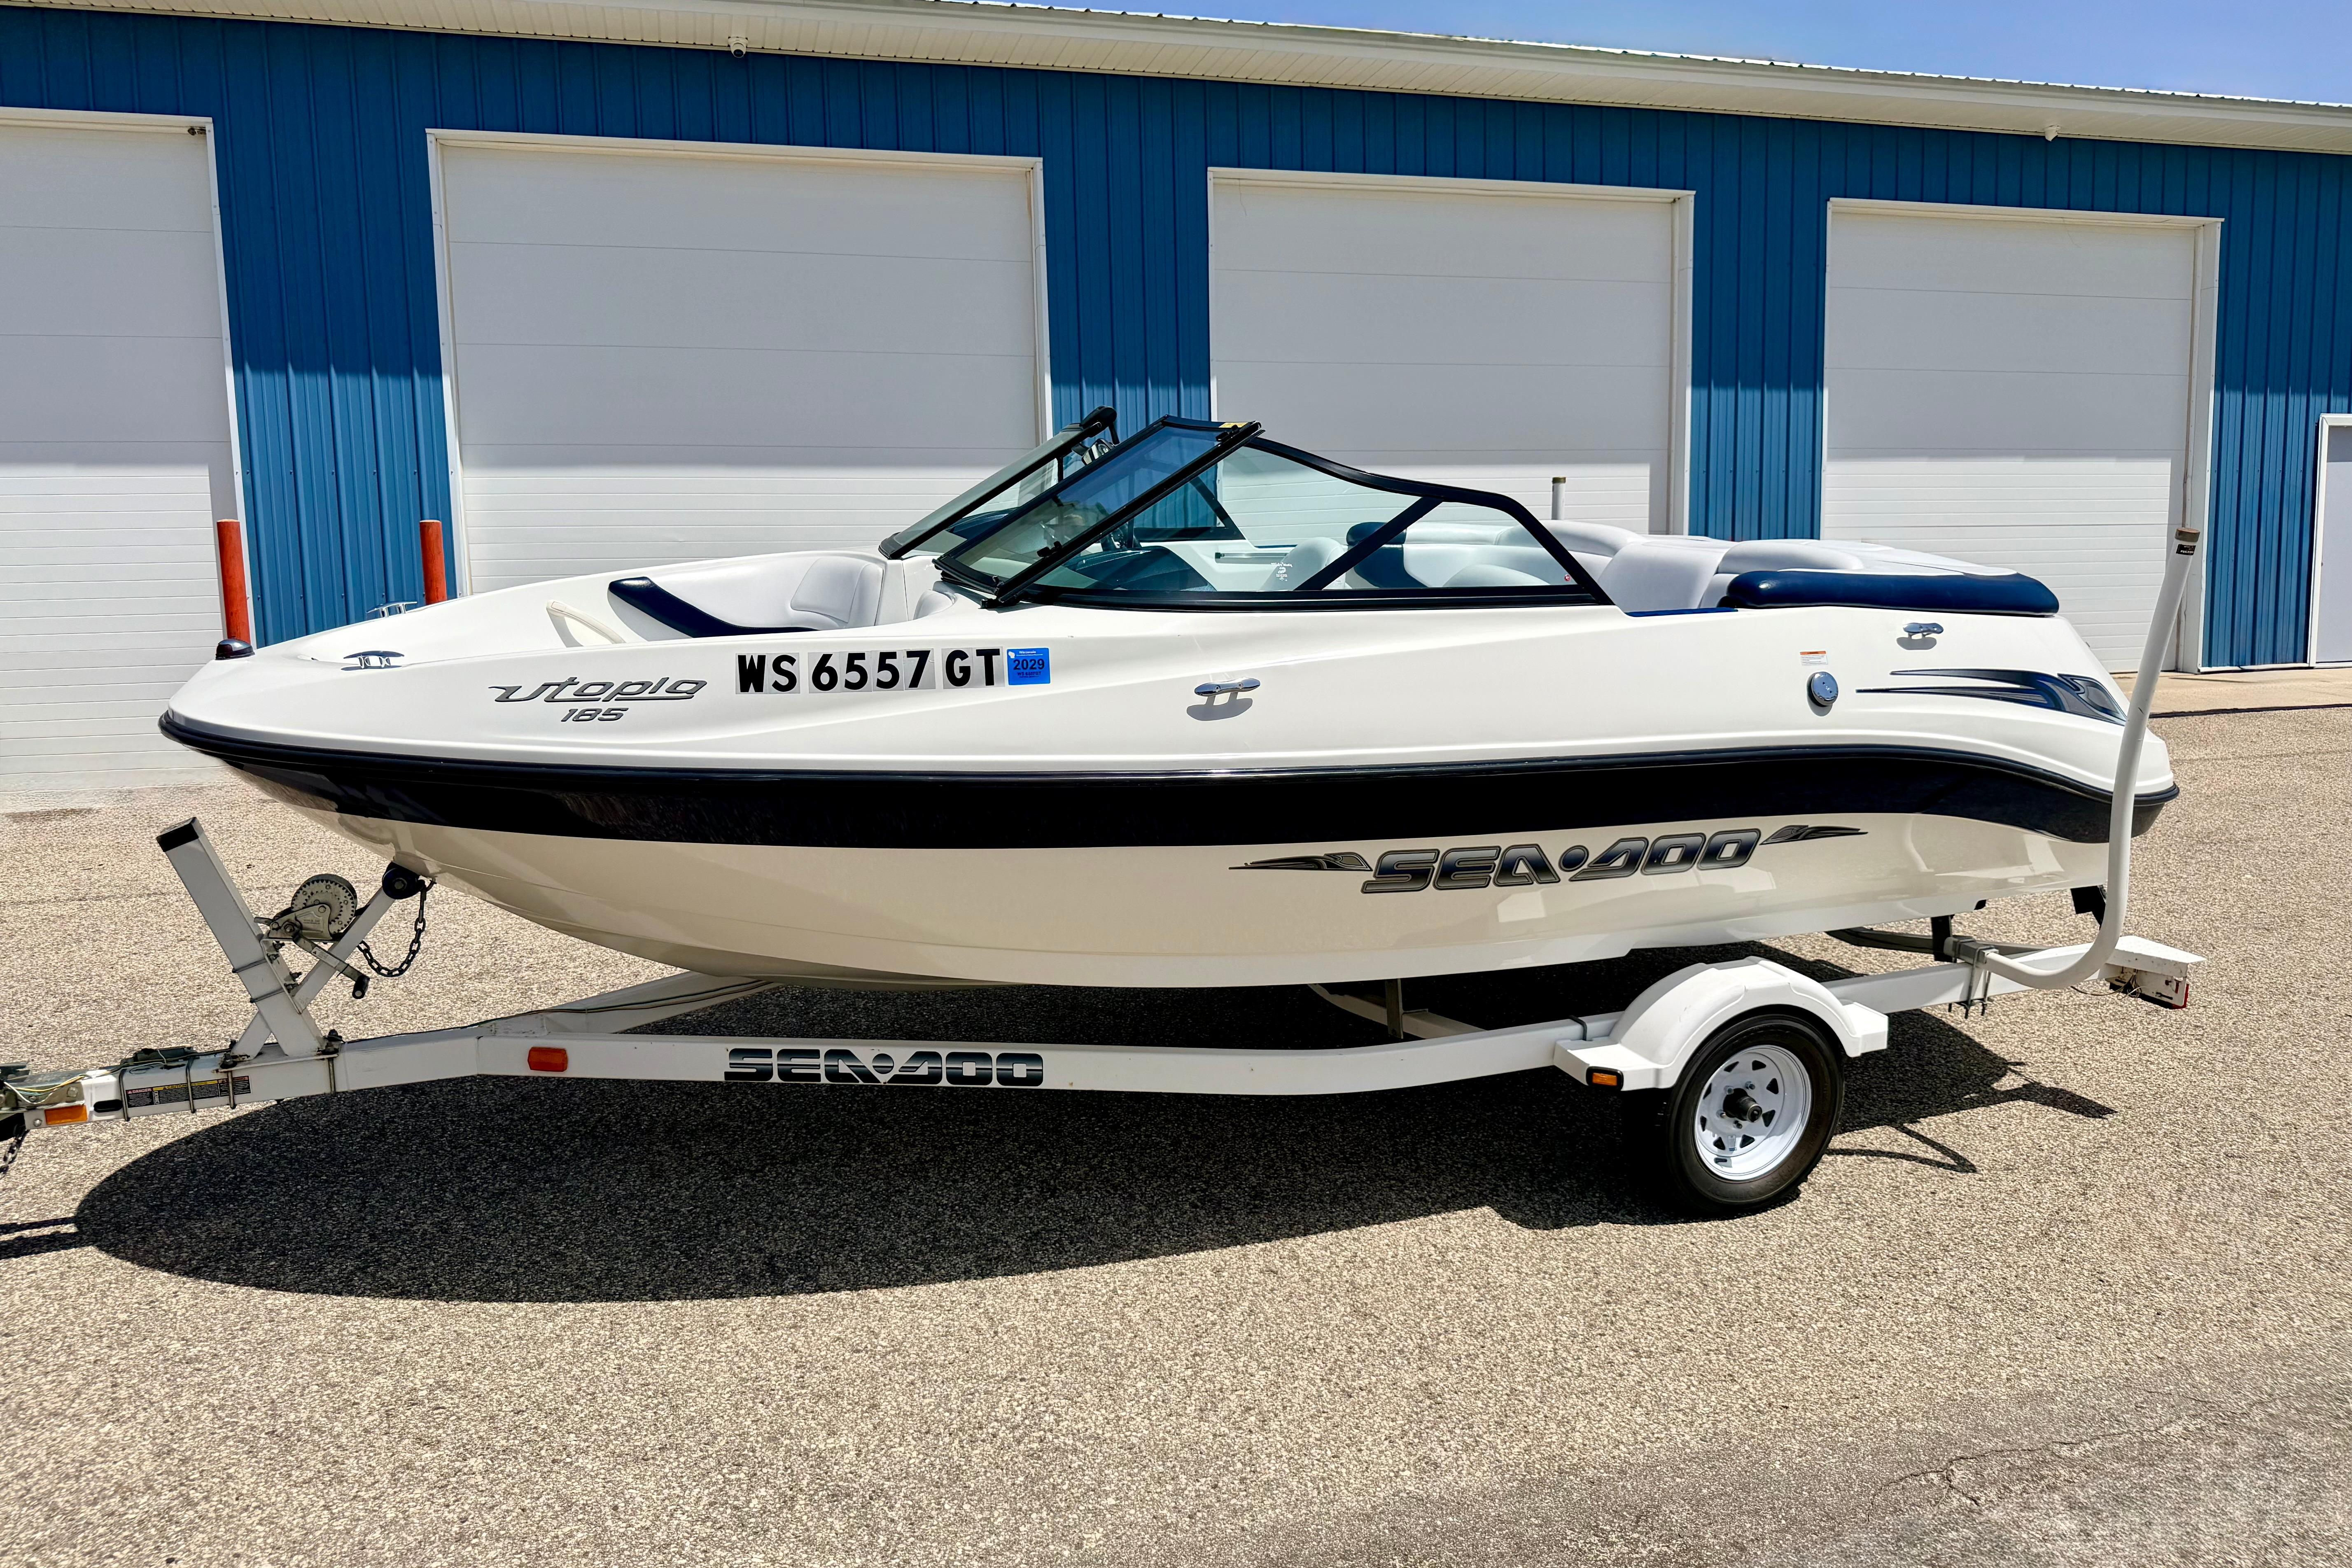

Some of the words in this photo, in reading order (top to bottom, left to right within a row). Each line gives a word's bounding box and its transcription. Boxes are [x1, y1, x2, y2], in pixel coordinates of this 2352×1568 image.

[738, 654, 797, 693] WS
[812, 650, 931, 691] 6557
[945, 649, 1000, 687] GT
[1013, 658, 1045, 670] 2029
[561, 707, 629, 722] 185
